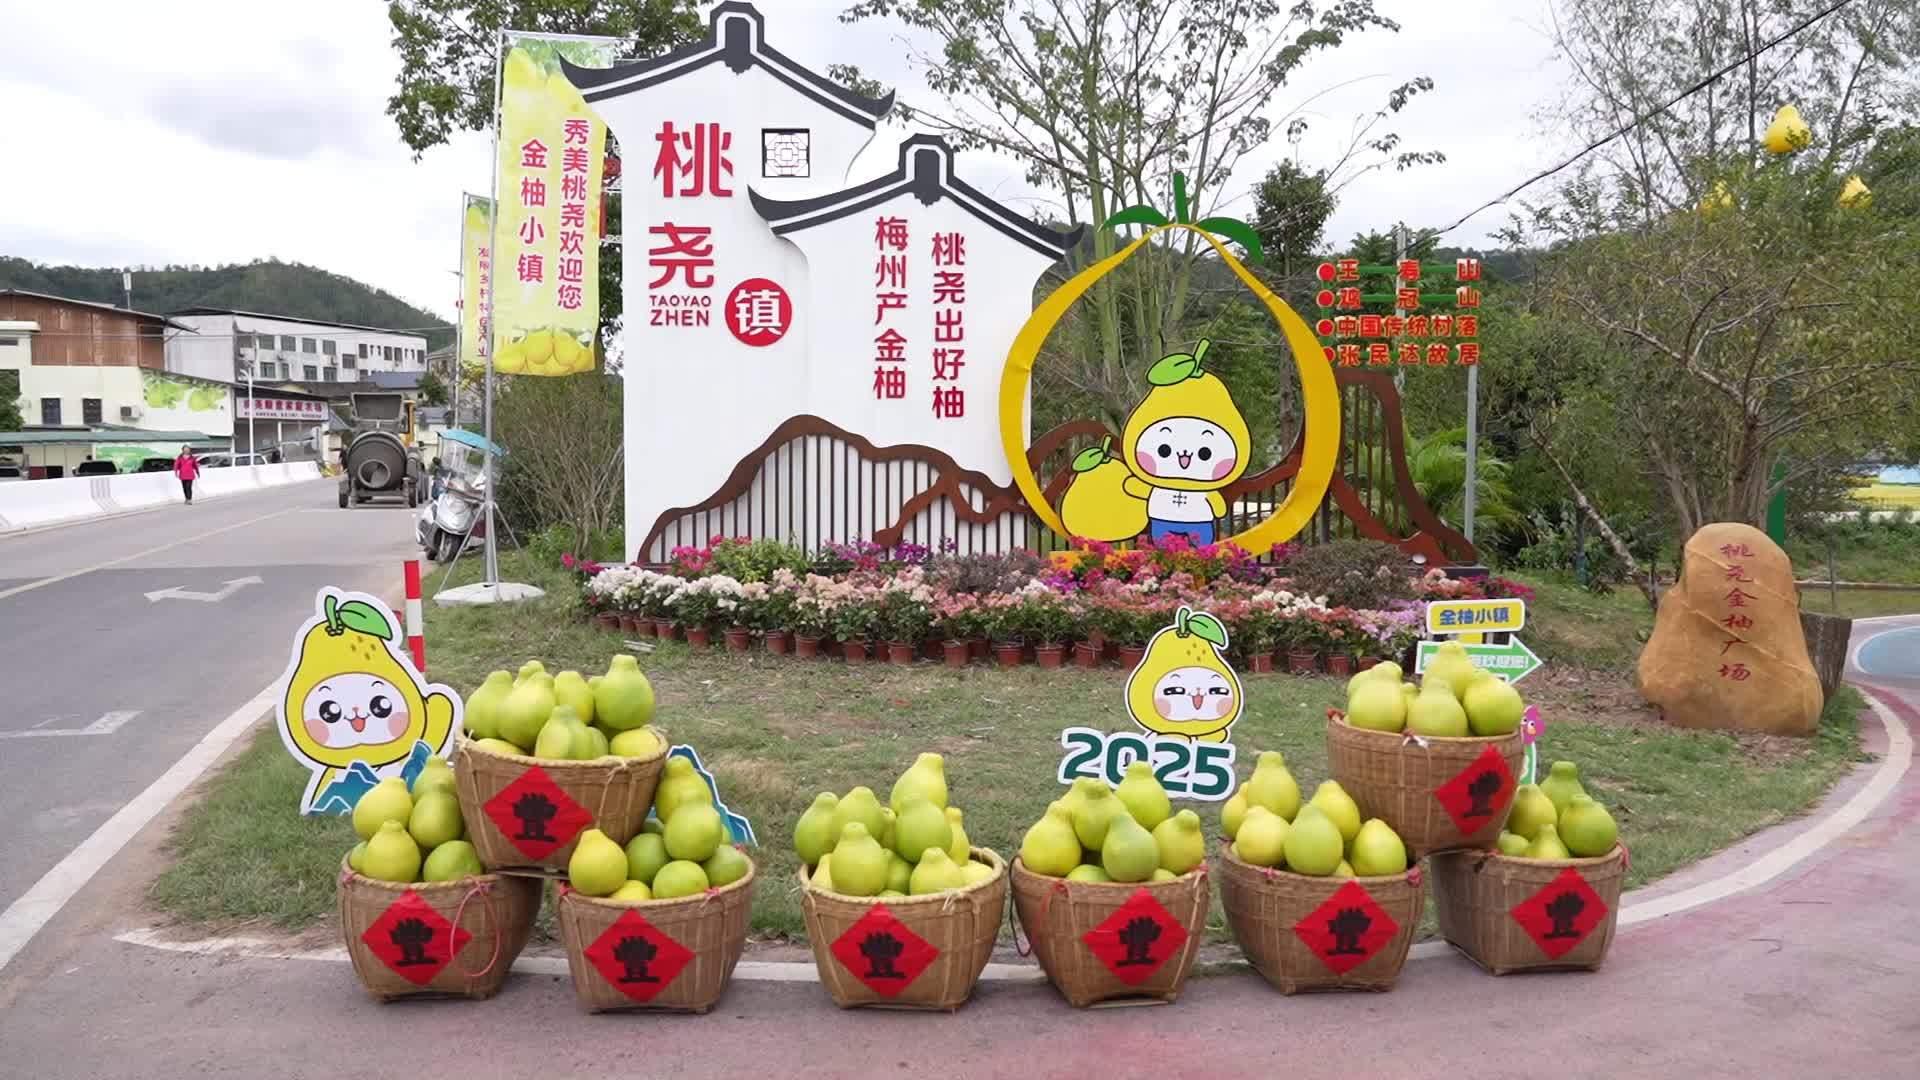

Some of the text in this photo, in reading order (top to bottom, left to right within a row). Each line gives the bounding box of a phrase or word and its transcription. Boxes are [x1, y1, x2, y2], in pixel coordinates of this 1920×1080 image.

[517, 139, 548, 283] 金柚小镇
[558, 119, 589, 310] 秀美桃尧欢迎您
[648, 121, 733, 289] 桃尧
[650, 295, 711, 307] TAOYAO
[650, 310, 709, 326] ZHEN
[733, 288, 785, 337] 镇
[873, 216, 908, 400] 梅州产金柚
[931, 232, 965, 419] 桃尧出好柚
[1335, 315, 1478, 337] 中国传统村落
[1337, 343, 1480, 366] 张民达故居
[1440, 607, 1509, 625] 金柚小镇
[1717, 543, 1758, 681] 桃尧金柚广场
[1063, 733, 1231, 796] 2025
